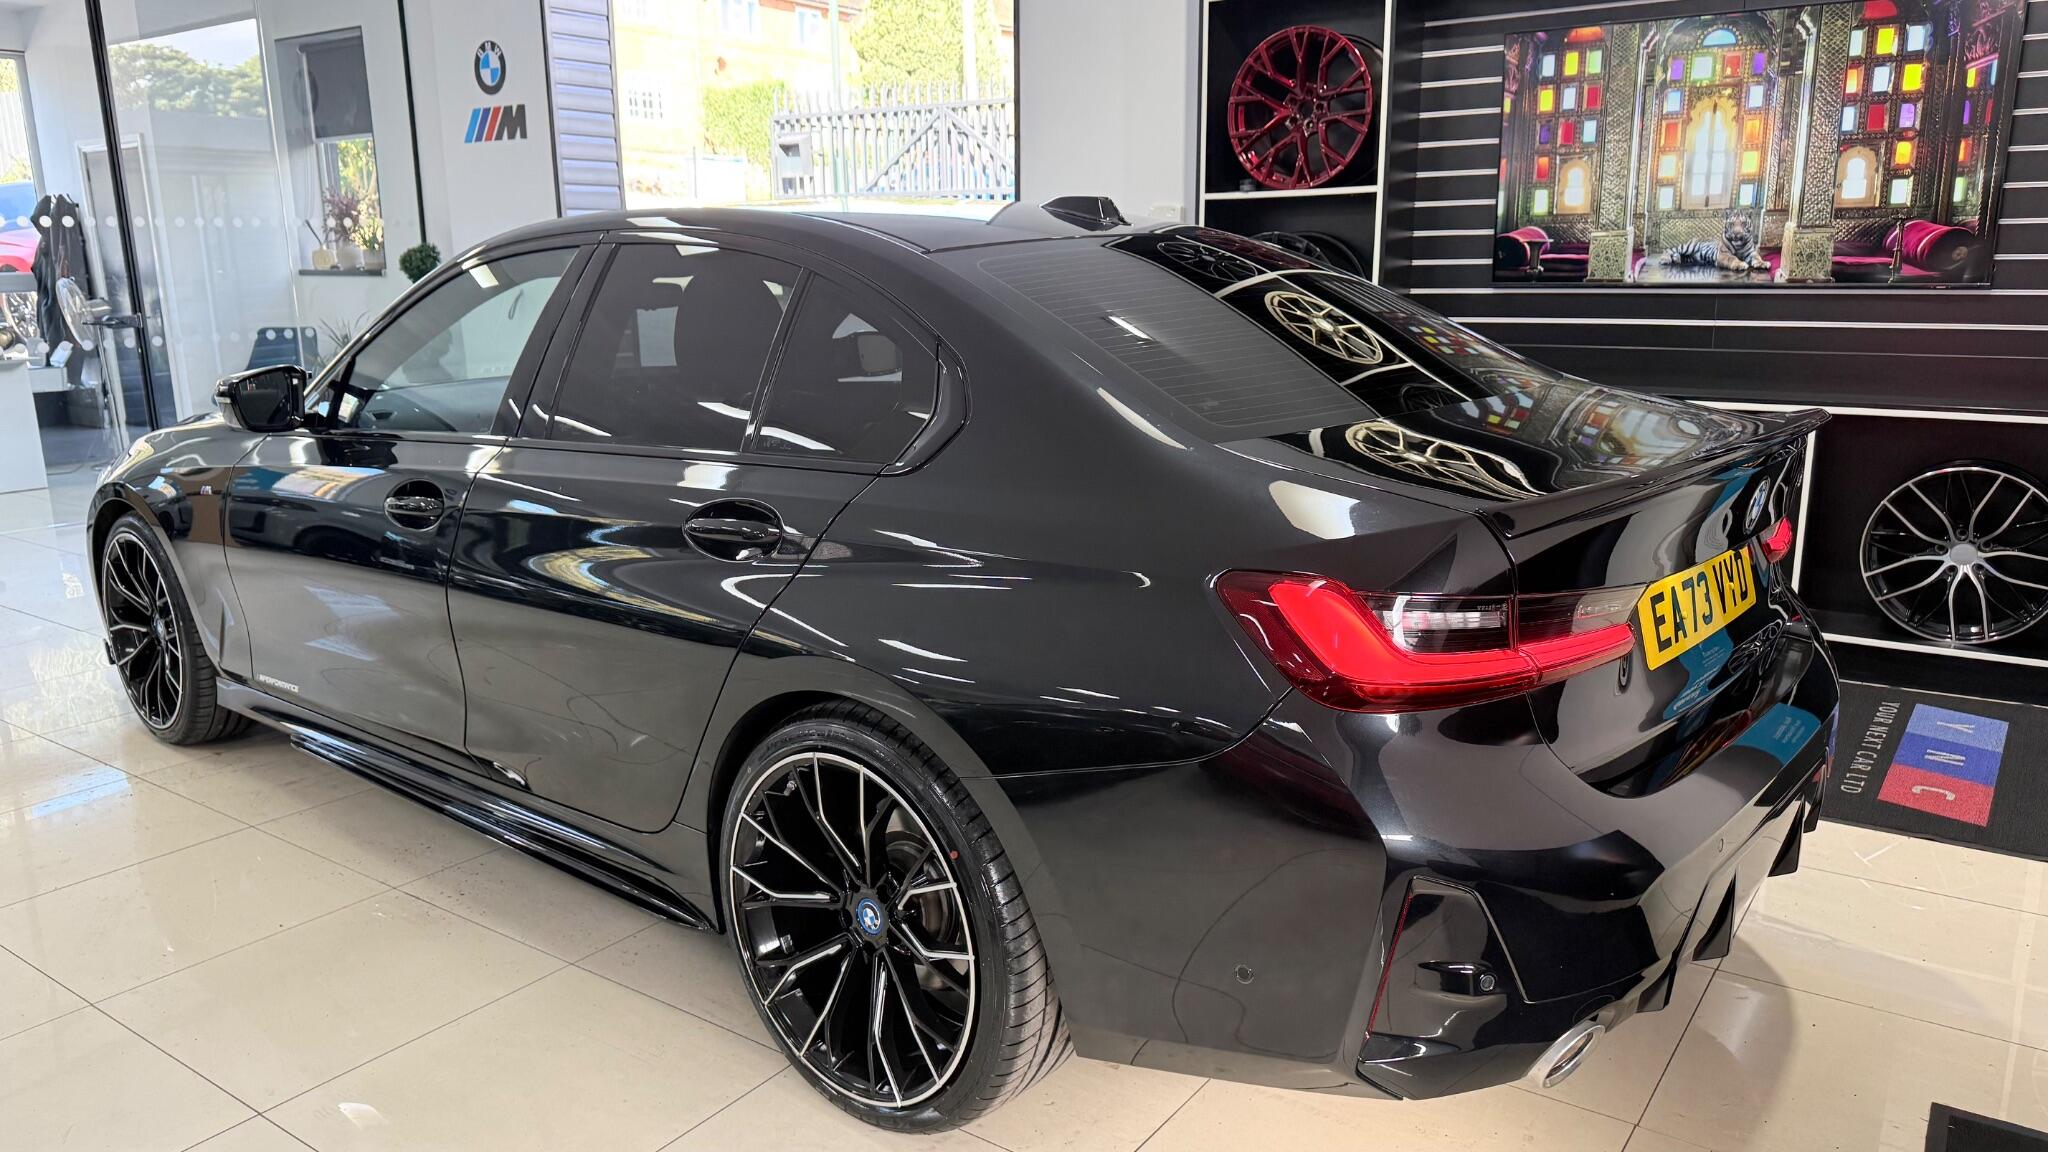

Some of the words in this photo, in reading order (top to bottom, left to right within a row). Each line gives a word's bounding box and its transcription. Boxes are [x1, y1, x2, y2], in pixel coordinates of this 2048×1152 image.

[477, 41, 502, 57] BMW
[1649, 571, 1713, 653] EA73
[1712, 552, 1748, 614] VYD
[1872, 702, 1901, 724] YOUR
[1862, 725, 1889, 750] NEXT
[1850, 751, 1877, 771] CAR
[1841, 773, 1868, 793] LTD
